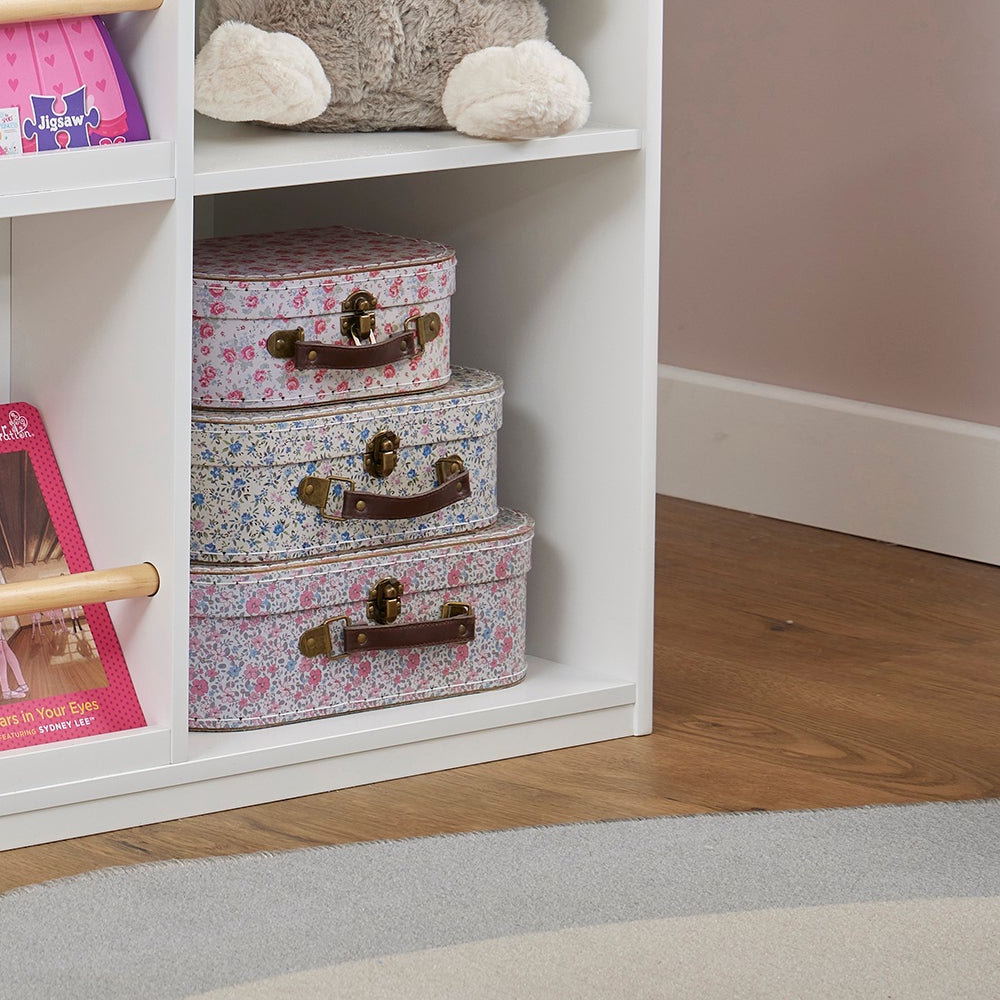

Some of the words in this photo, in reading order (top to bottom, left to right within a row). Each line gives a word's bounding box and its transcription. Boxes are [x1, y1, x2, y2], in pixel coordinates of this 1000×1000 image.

[37, 114, 85, 133] Jigsaw
[20, 709, 35, 723] in
[35, 704, 66, 720] Your
[68, 700, 100, 716] Eyes
[38, 720, 72, 734] SYDNEY
